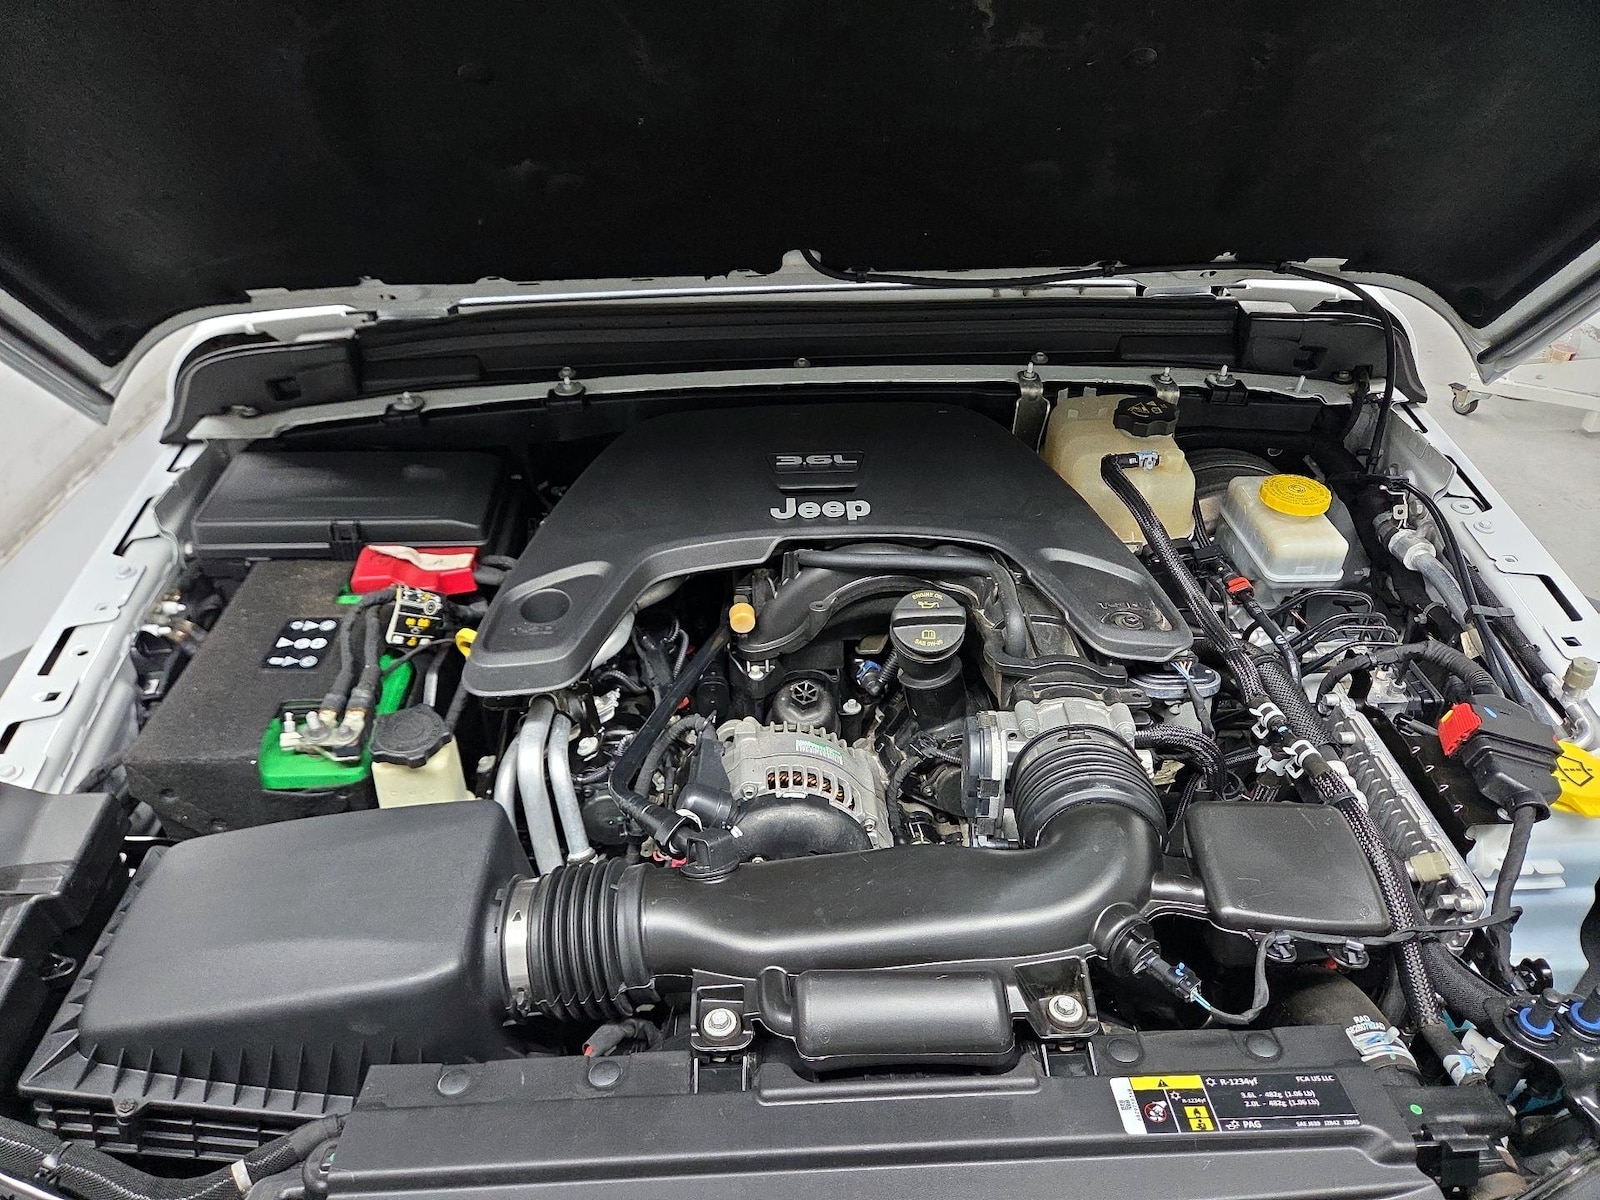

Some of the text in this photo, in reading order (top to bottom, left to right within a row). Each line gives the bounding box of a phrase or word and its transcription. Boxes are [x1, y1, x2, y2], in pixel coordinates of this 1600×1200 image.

[776, 454, 858, 467] 3.6L
[770, 497, 871, 521] Jeep
[911, 592, 944, 601] ENGINE OIL
[1220, 1077, 1258, 1087] R-1234yf
[1240, 1091, 1257, 1099] 3.6L
[1243, 1120, 1262, 1129] PAG
